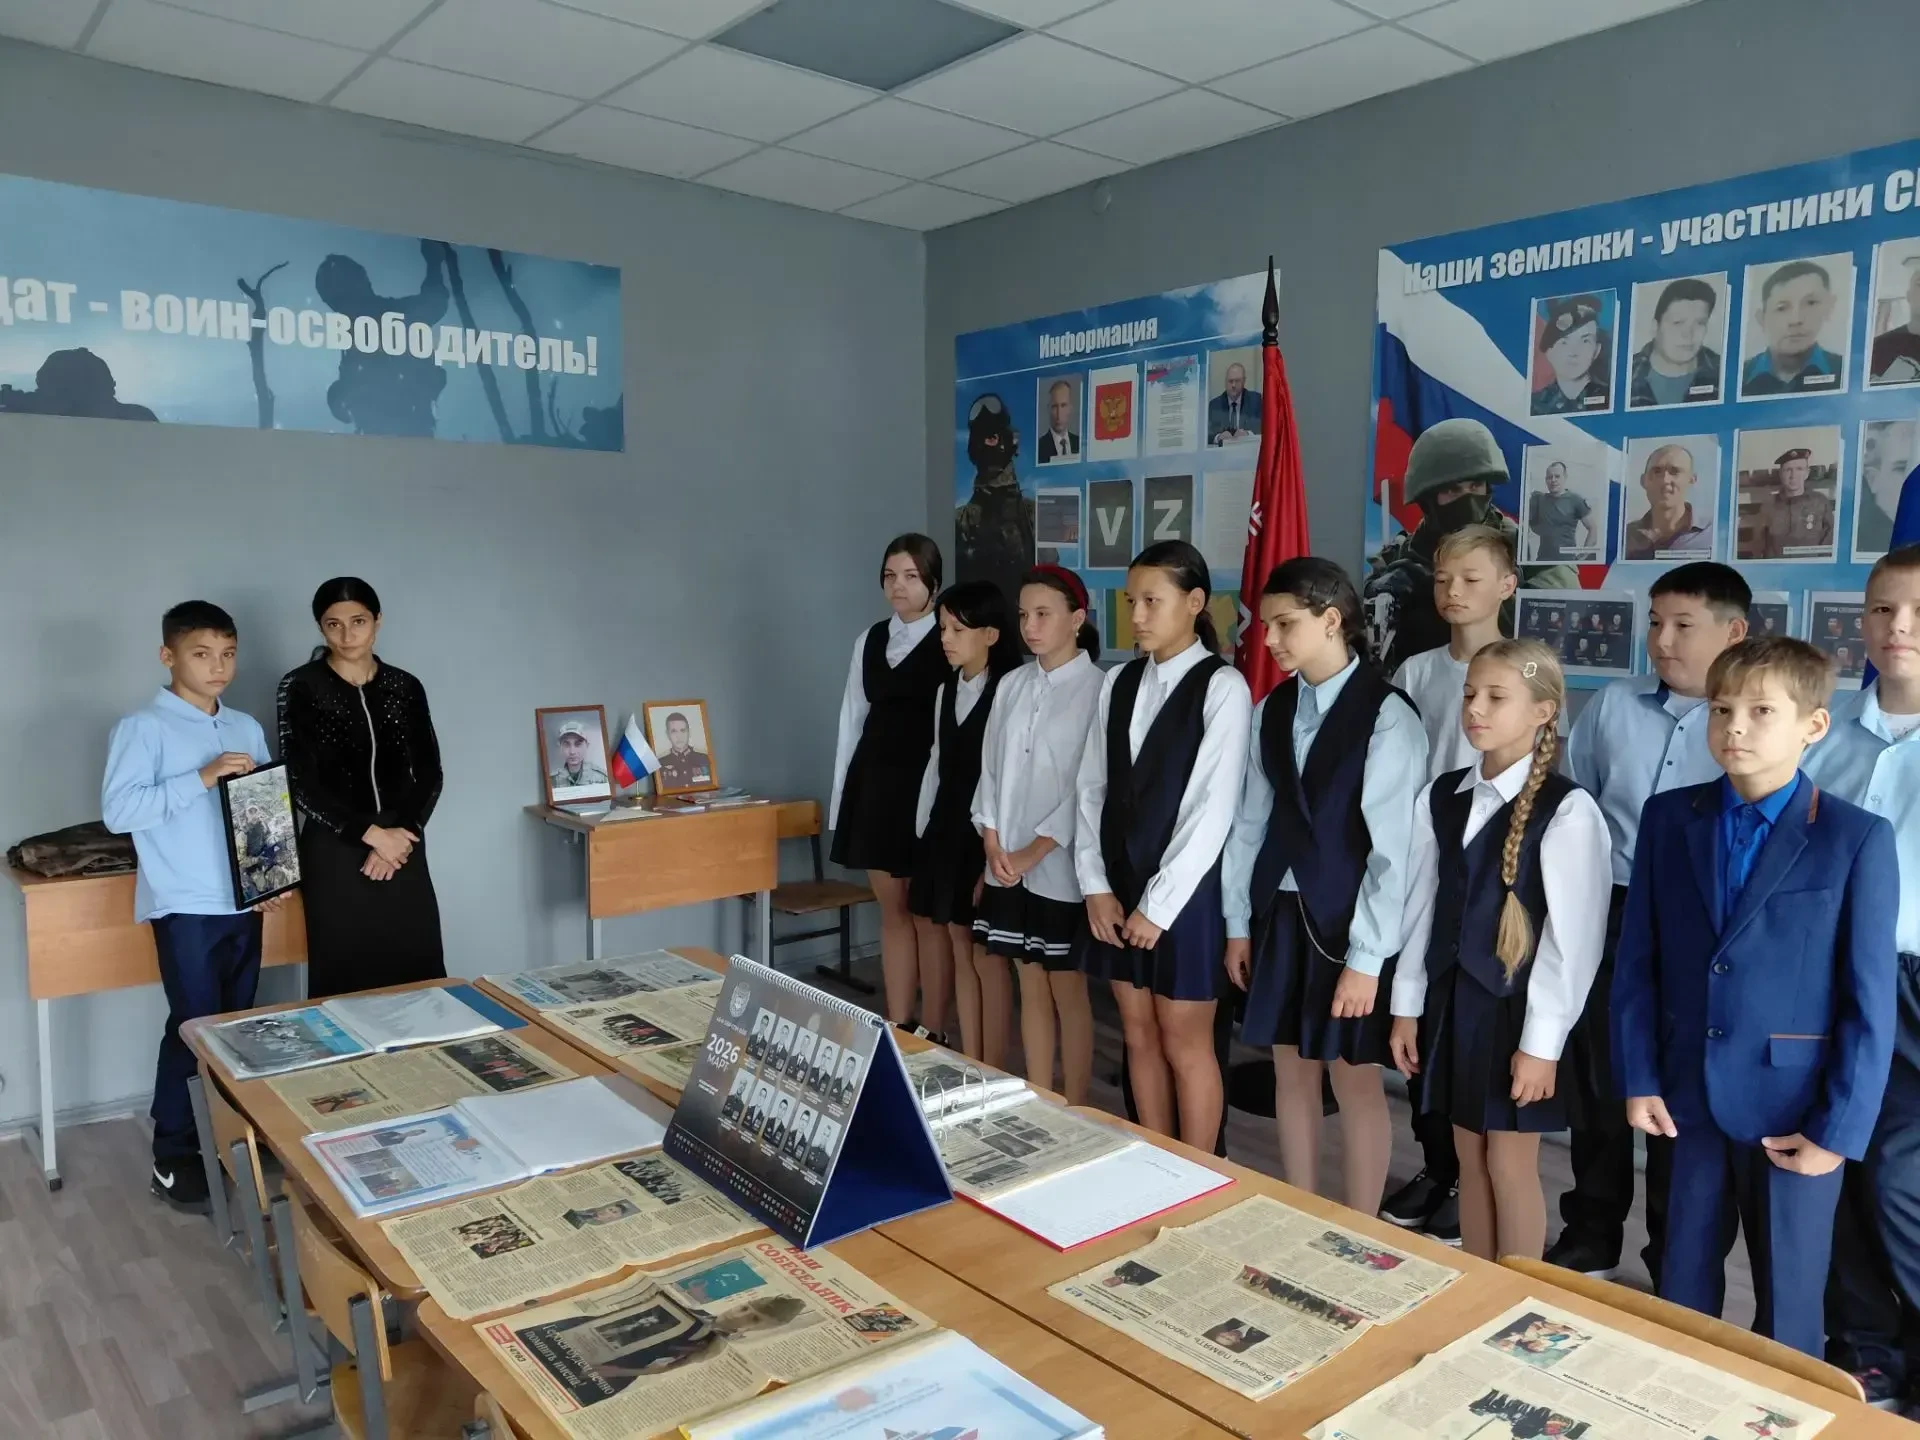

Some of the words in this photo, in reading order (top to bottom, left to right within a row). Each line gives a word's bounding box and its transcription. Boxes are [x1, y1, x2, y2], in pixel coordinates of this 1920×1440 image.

[1403, 256, 1483, 295] Наши
[1489, 229, 1634, 279] земляки
[1641, 235, 1653, 244] -
[1660, 183, 1873, 254] участники
[1884, 168, 1920, 212] С
[89, 301, 108, 311] -
[1039, 317, 1158, 359] Информация
[1096, 507, 1126, 546] V
[1153, 500, 1183, 540] Z
[706, 1033, 741, 1063] 2026
[706, 1054, 730, 1072] МАРТ
[756, 1242, 857, 1314] СОБЕСЕДНИК
[524, 1330, 557, 1362] помнить
[1193, 1337, 1232, 1360] память
[587, 1371, 615, 1395] вечно
[1233, 1359, 1274, 1382] Вечная
